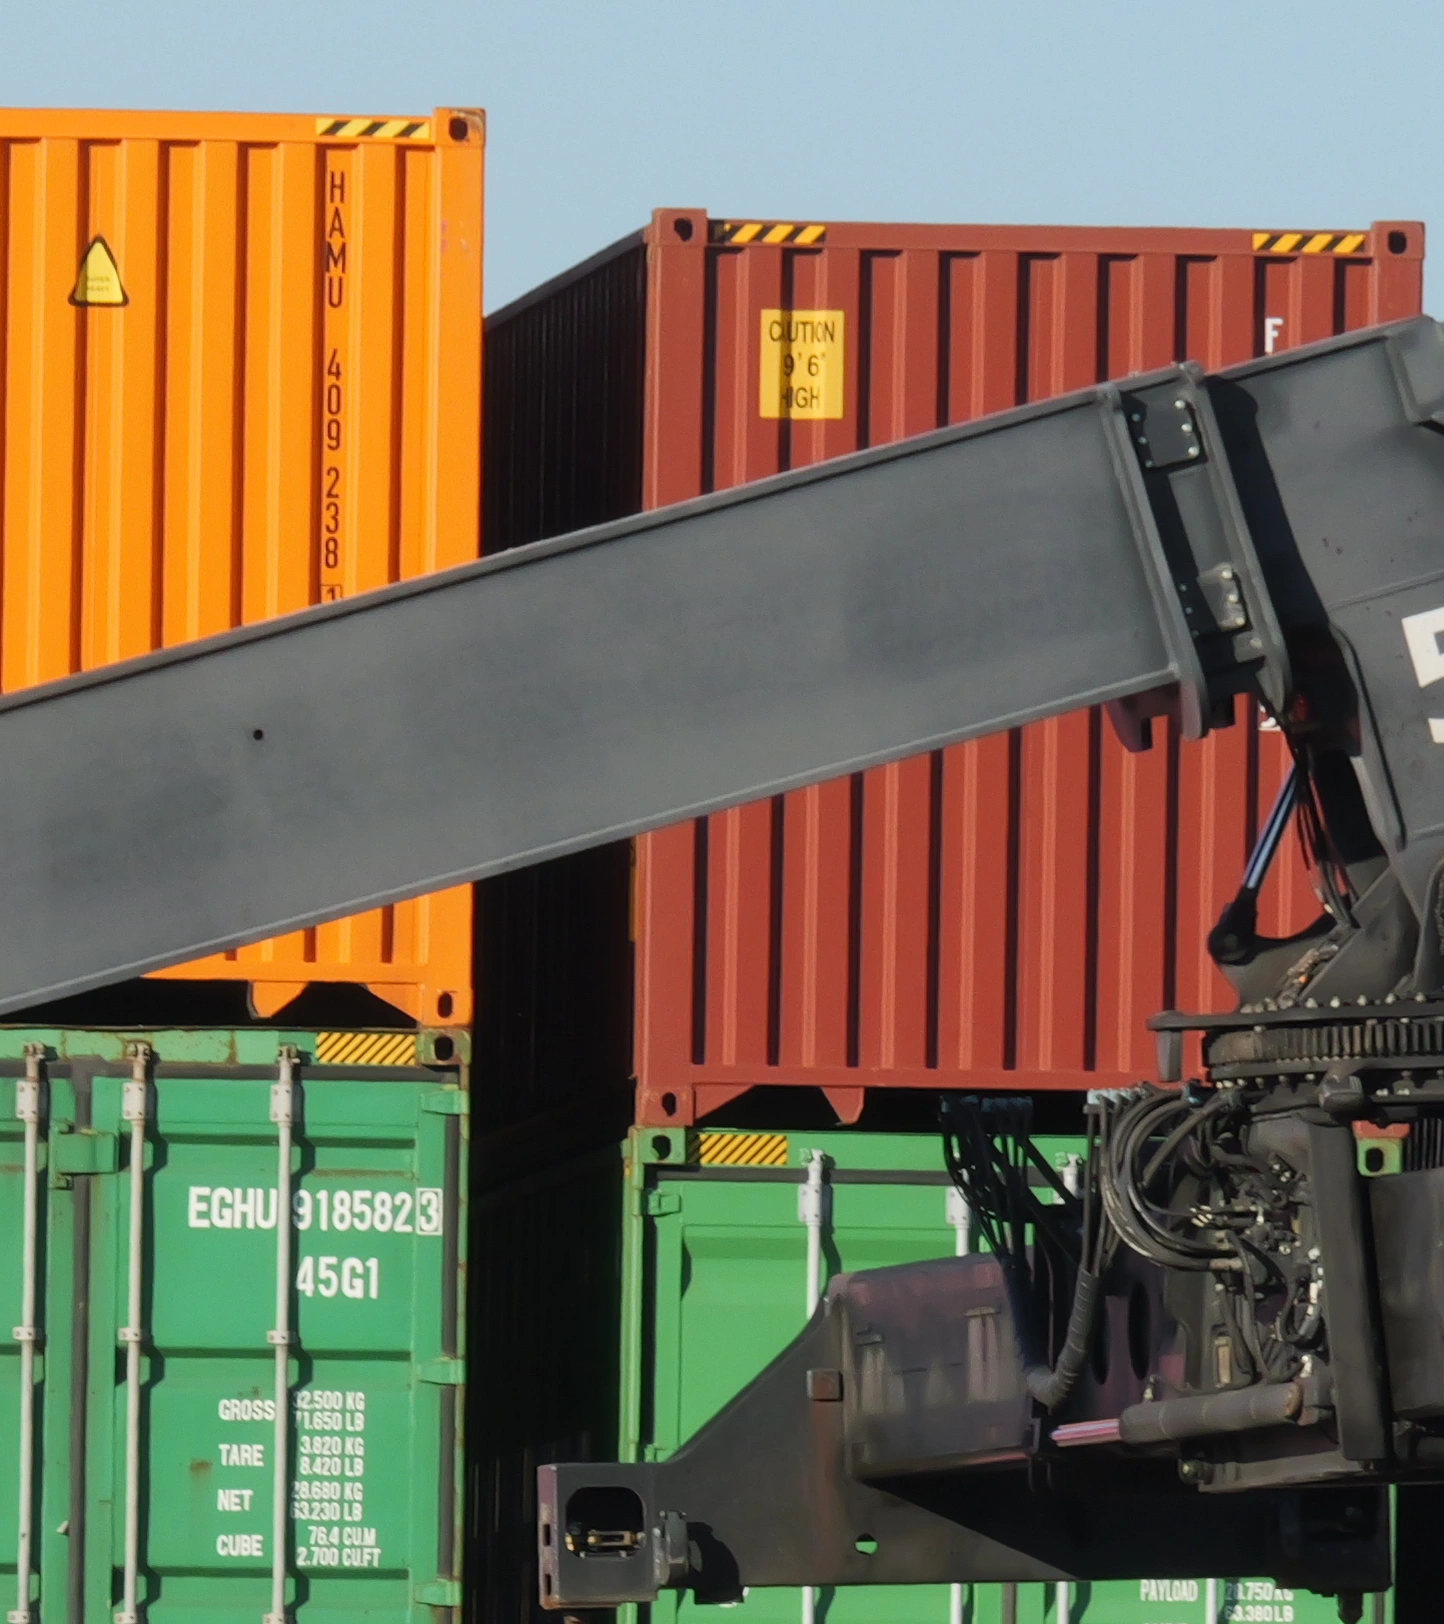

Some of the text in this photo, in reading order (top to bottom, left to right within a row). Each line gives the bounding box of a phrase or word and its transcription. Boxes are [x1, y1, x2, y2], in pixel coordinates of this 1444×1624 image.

[325, 171, 346, 309] HAMU
[188, 1186, 441, 1234] EGHU 918582 3
[296, 1256, 378, 1299] 45G1
[218, 1399, 275, 1421] GROSS
[345, 1391, 365, 1411] KG
[345, 1412, 364, 1431] LB
[218, 1444, 264, 1466] TARE
[300, 1436, 364, 1456] 3.820 KG
[300, 1457, 364, 1477] 8.420 LB
[218, 1489, 252, 1511] NET
[344, 1481, 363, 1501] KG
[343, 1502, 362, 1521] LB
[217, 1535, 264, 1557] CUBE
[308, 1526, 339, 1546] 76.4
[297, 1547, 340, 1566] 2.700
[1139, 1580, 1199, 1601] PAYLOAD
[1274, 1605, 1294, 1622] LB
